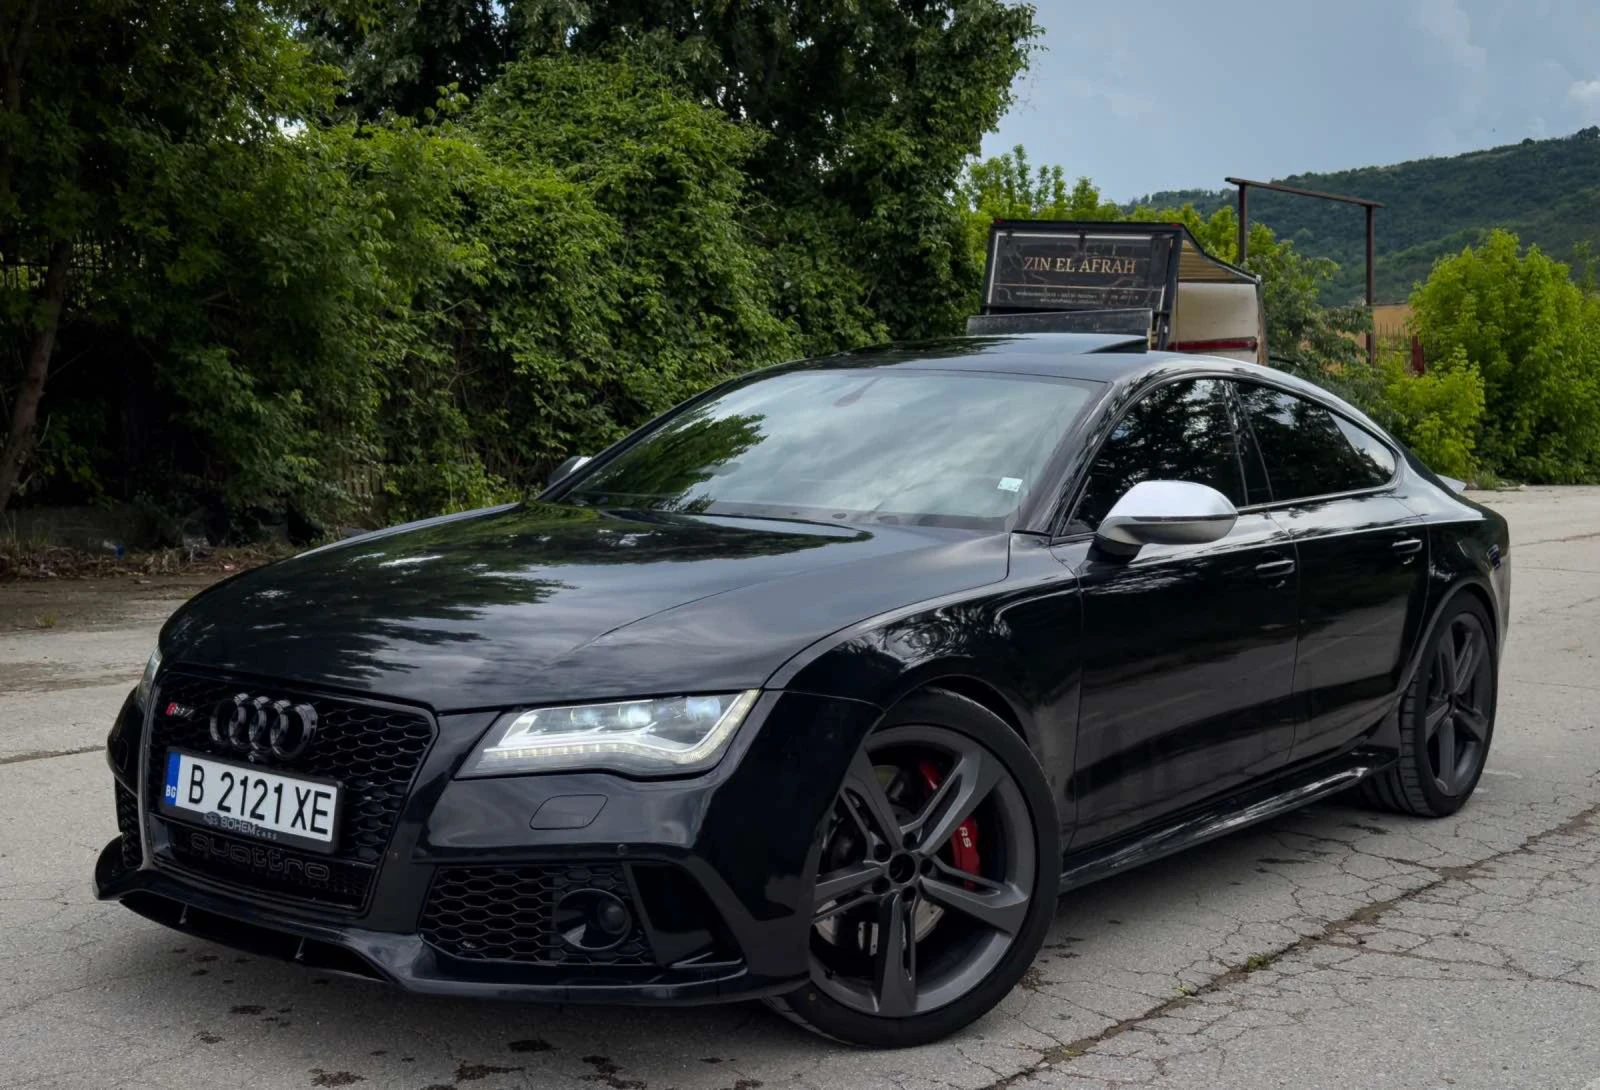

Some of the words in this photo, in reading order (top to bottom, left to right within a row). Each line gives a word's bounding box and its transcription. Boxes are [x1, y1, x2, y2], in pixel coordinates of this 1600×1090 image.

[1023, 256, 1052, 272] ZIN
[1055, 257, 1075, 273] EL
[1078, 258, 1137, 274] AFRAH
[165, 785, 177, 799] BG
[188, 764, 205, 805] B
[217, 771, 284, 825] 2121
[290, 785, 332, 836] XE
[959, 826, 972, 848] RS
[190, 832, 330, 881] quattro
